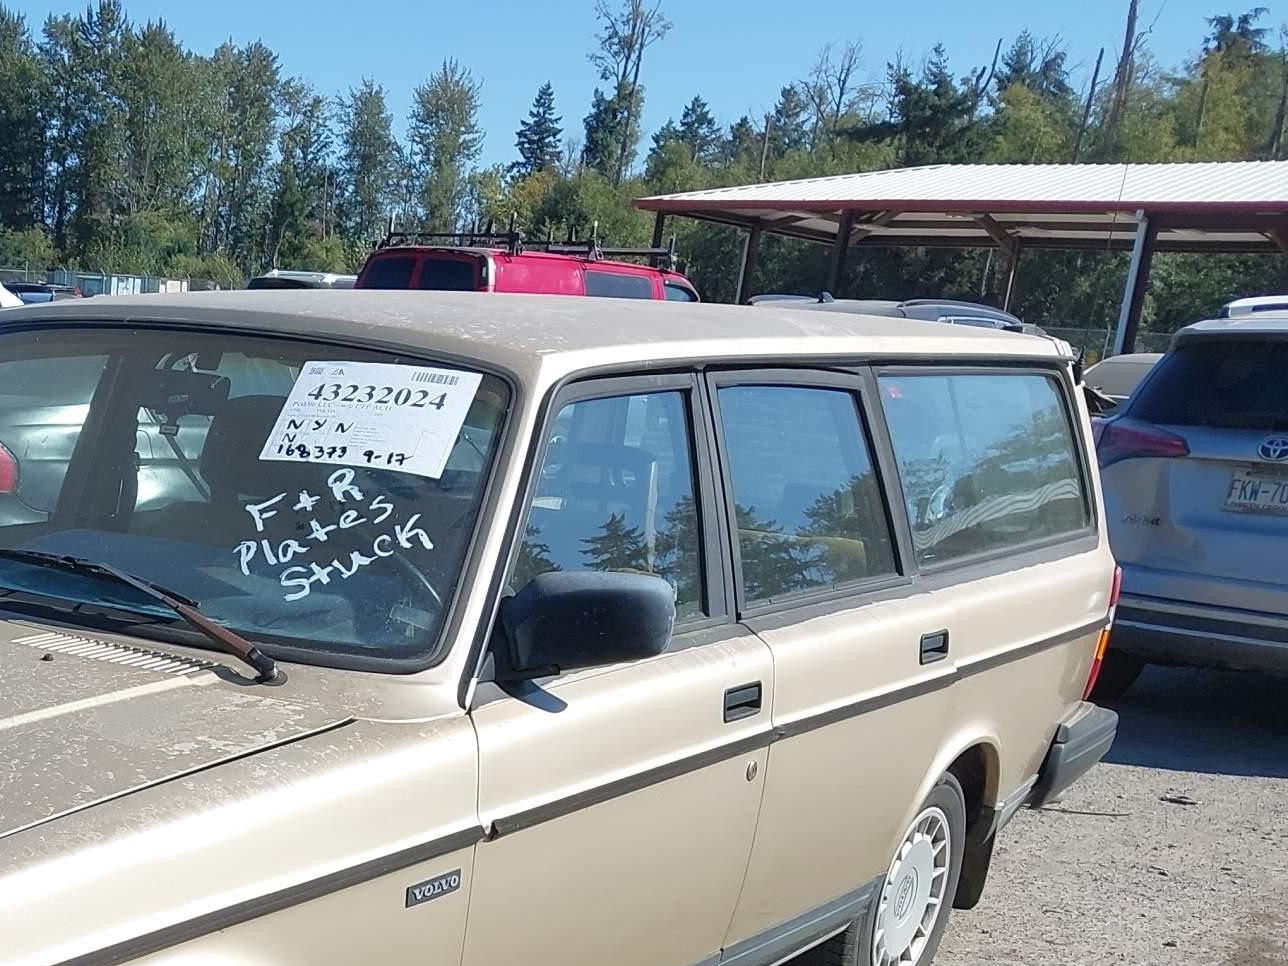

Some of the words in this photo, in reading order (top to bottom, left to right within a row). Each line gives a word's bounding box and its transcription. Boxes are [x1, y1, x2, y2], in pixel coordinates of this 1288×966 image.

[307, 383, 448, 410] 43232024
[245, 492, 288, 532] F
[327, 468, 364, 502] R
[412, 875, 459, 900] VOLVO
